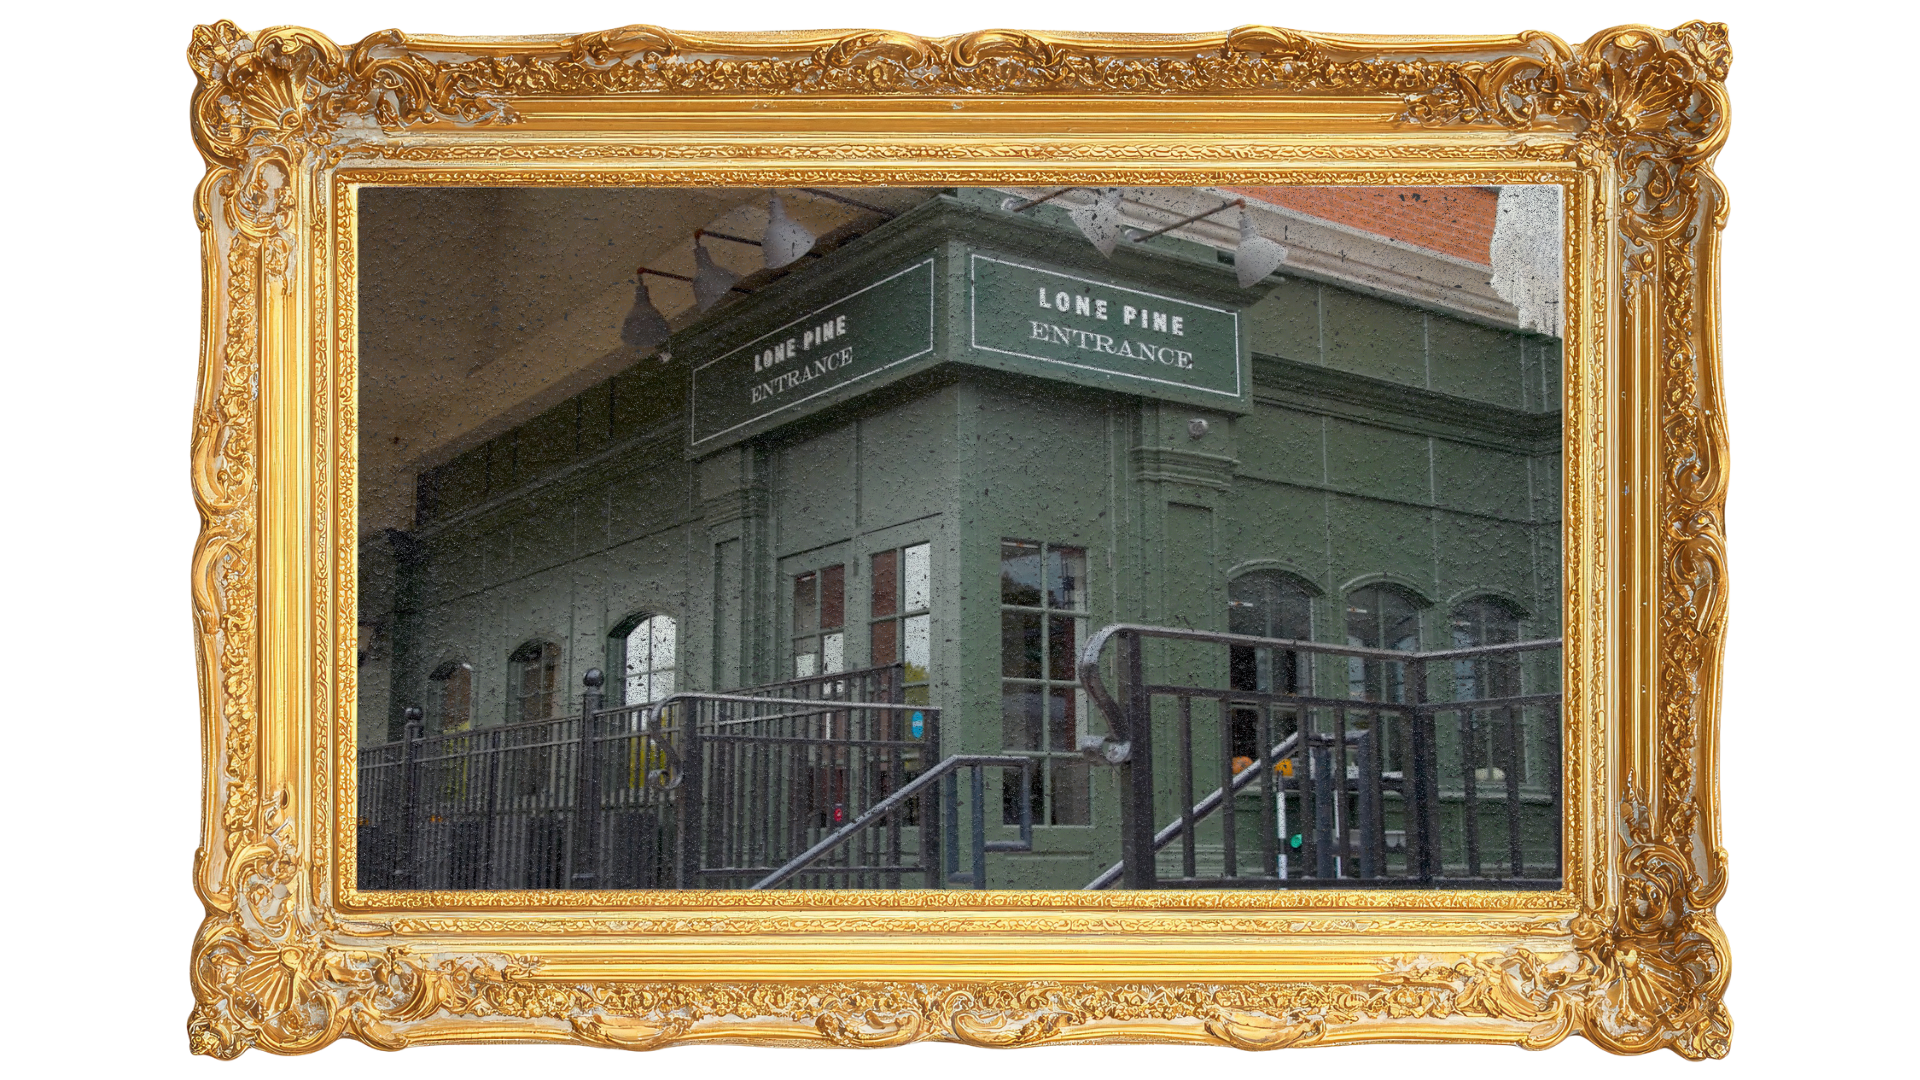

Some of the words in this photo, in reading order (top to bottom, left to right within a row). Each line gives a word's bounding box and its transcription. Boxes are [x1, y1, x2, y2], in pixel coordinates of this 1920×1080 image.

[1039, 287, 1108, 321] LONE
[1123, 305, 1184, 336] PINE
[754, 338, 796, 373] LONE
[803, 315, 847, 350] PINE
[1029, 320, 1193, 370] ENTRANCE
[751, 346, 853, 404] ENTRANCE
